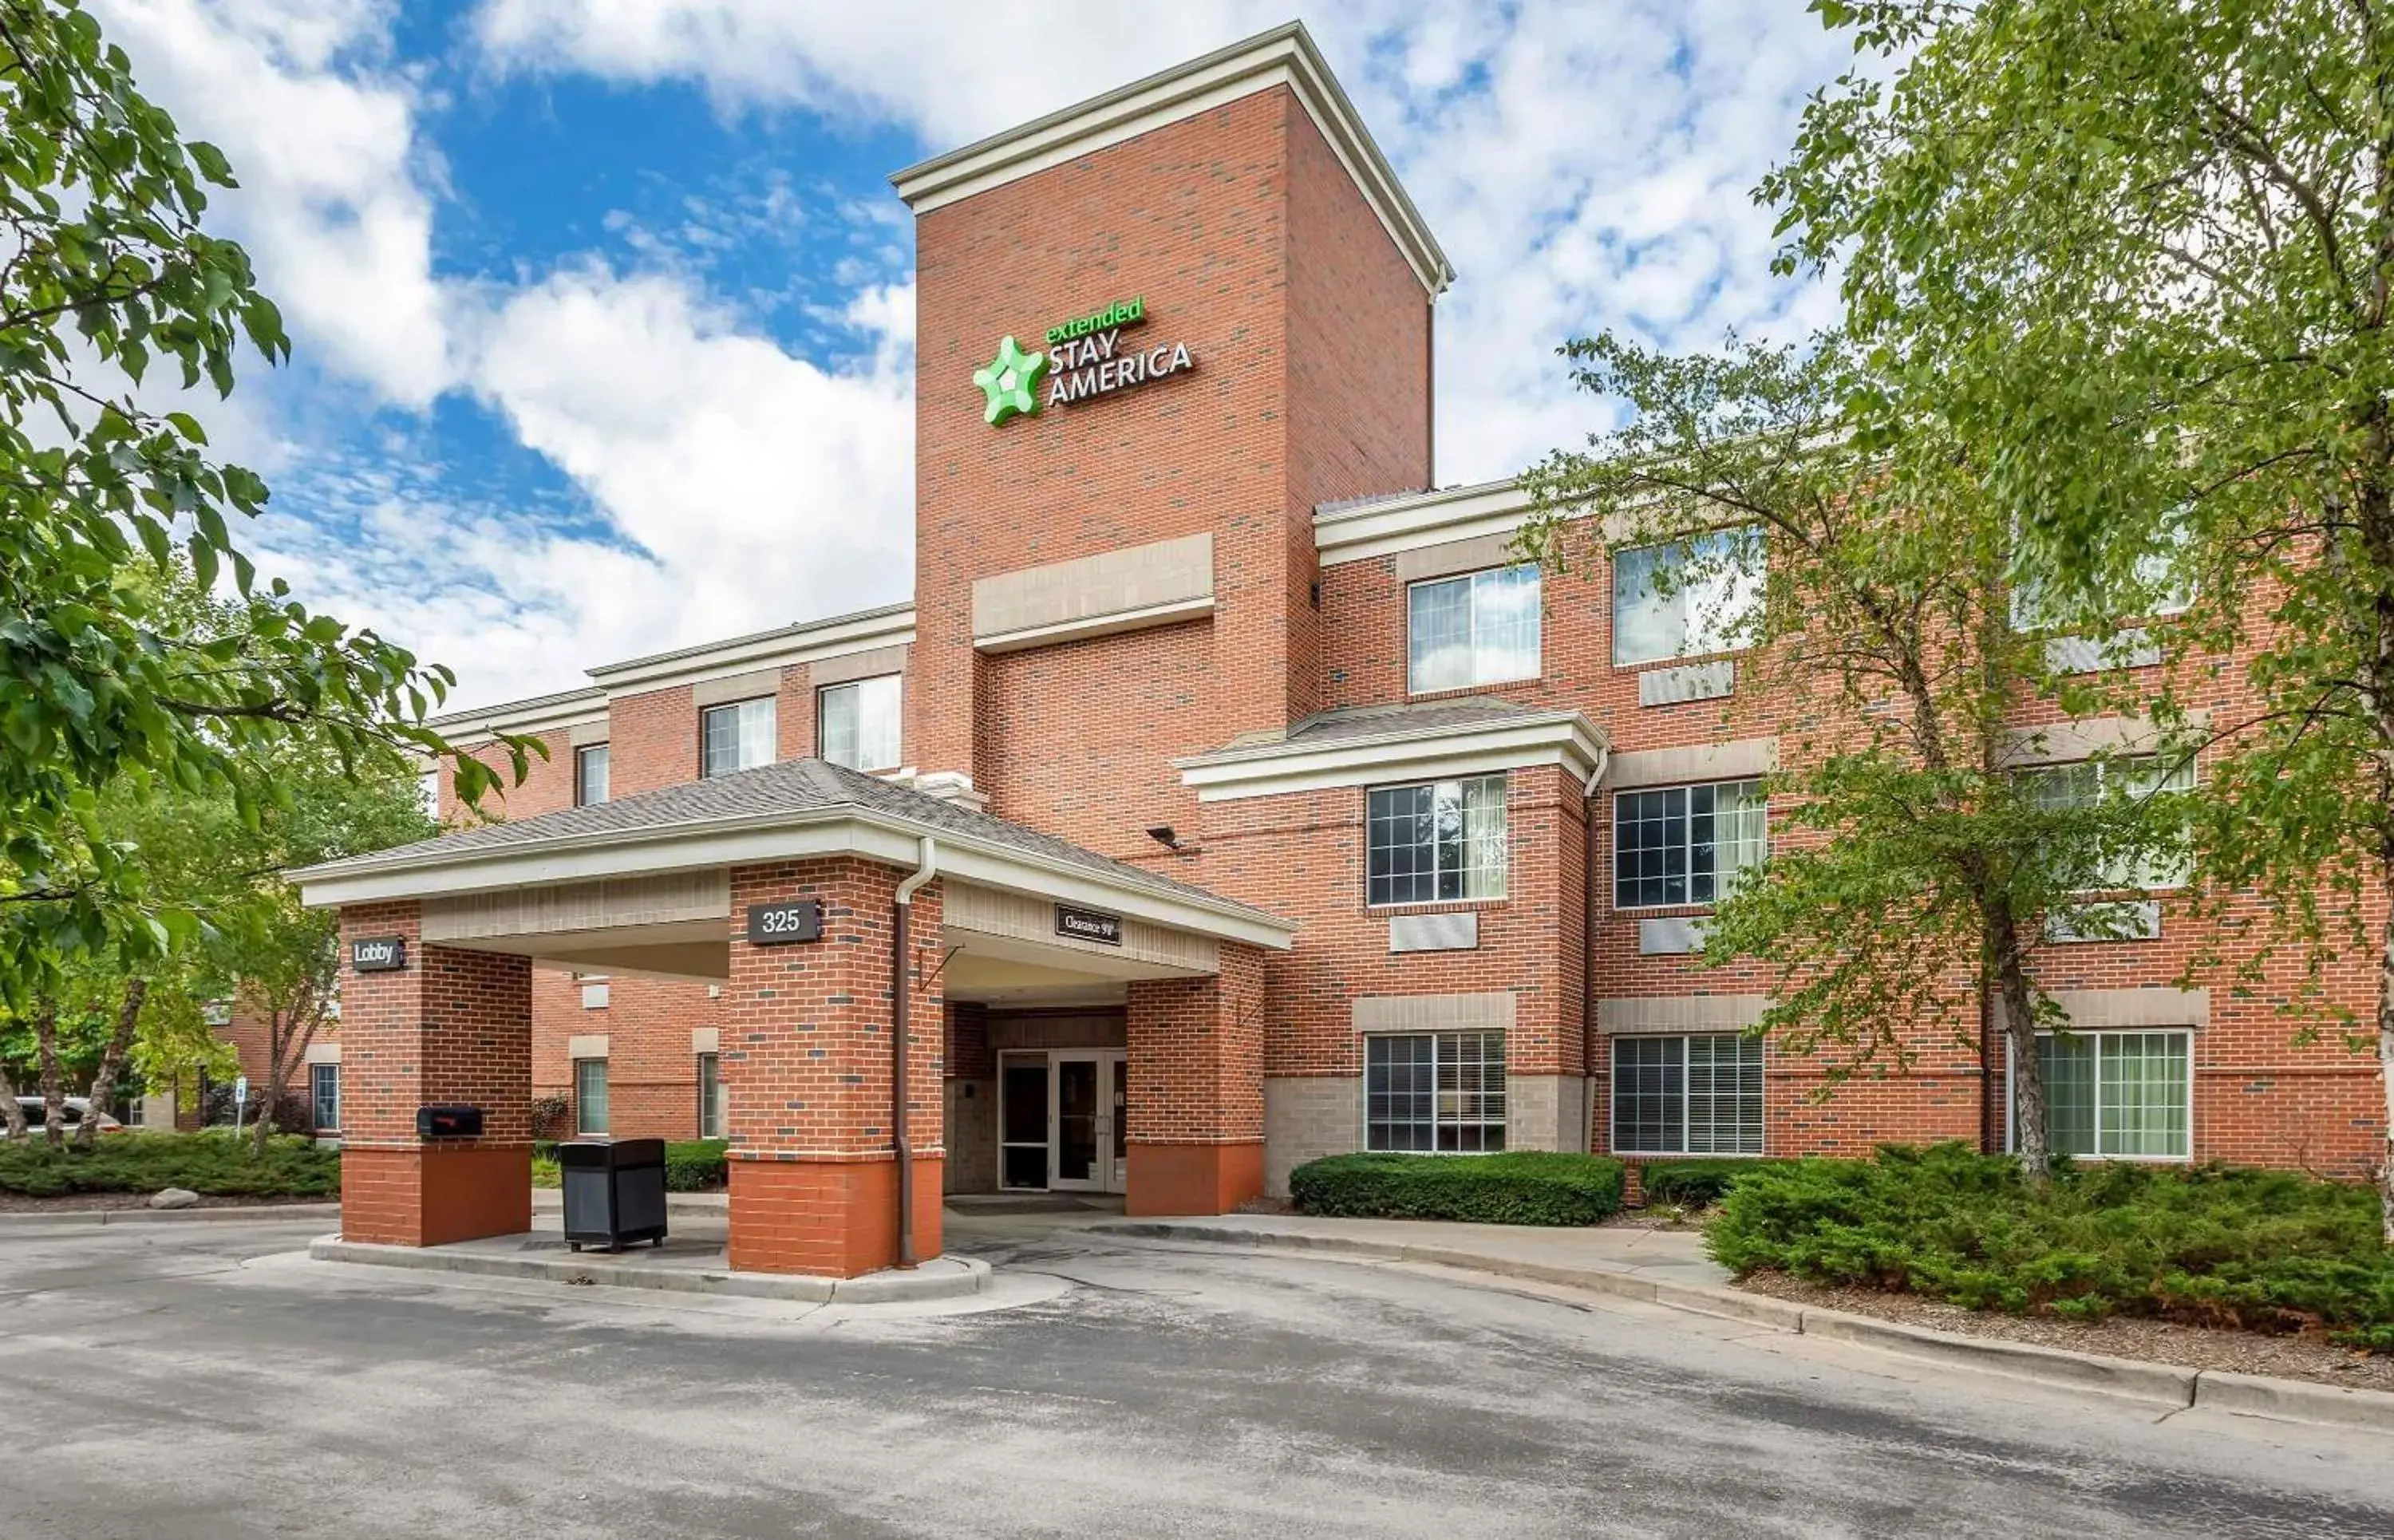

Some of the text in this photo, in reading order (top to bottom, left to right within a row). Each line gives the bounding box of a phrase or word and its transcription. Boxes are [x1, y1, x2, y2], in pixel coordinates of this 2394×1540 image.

[1045, 294, 1144, 344] extended
[1049, 329, 1118, 374] STAY
[1048, 342, 1192, 407] AMERICA
[763, 910, 800, 933] 325
[355, 942, 393, 965] Lobby
